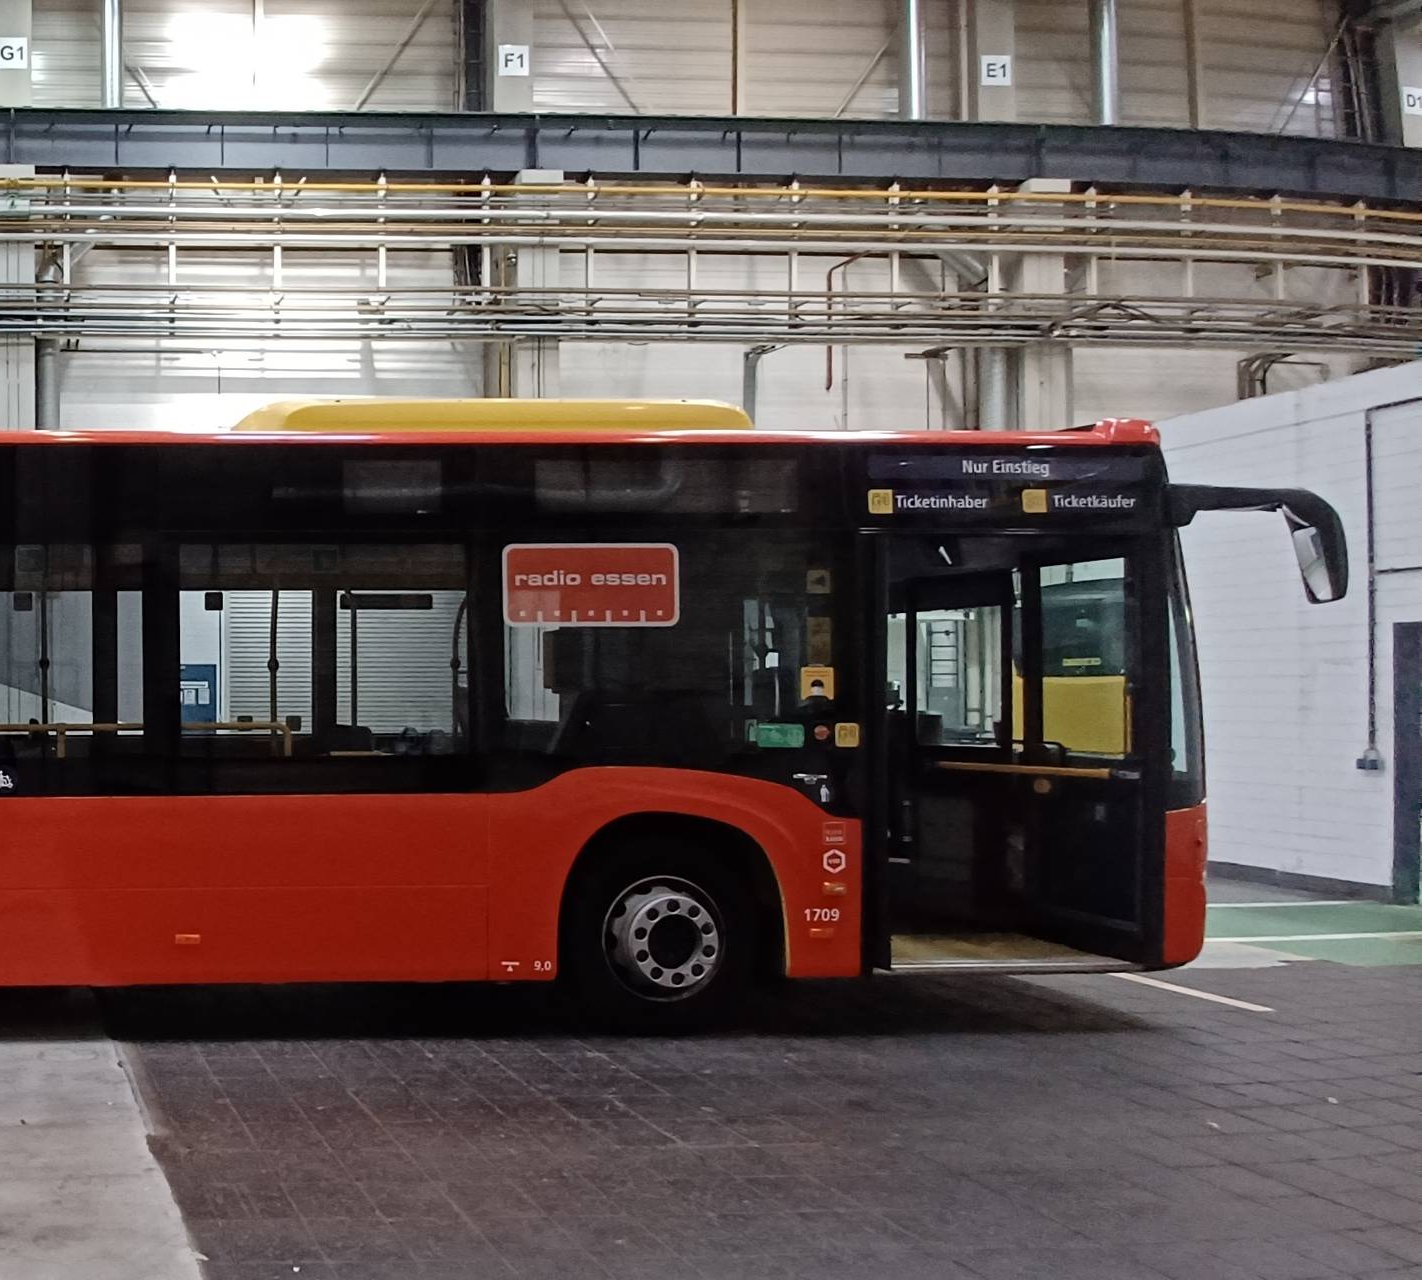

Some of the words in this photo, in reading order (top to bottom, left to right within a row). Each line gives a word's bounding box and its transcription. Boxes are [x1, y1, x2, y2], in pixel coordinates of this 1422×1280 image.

[0, 45, 24, 61] G1
[504, 53, 524, 68] F1
[986, 63, 1006, 78] E1
[962, 460, 988, 474] Nur
[992, 460, 1050, 477] Einstieg
[895, 495, 988, 509] Ticketinhaber
[1053, 494, 1136, 508] Ticketkäufer
[514, 570, 581, 586] radio
[591, 573, 666, 585] essen
[804, 908, 840, 922] 1709
[533, 960, 552, 972] 9,0
